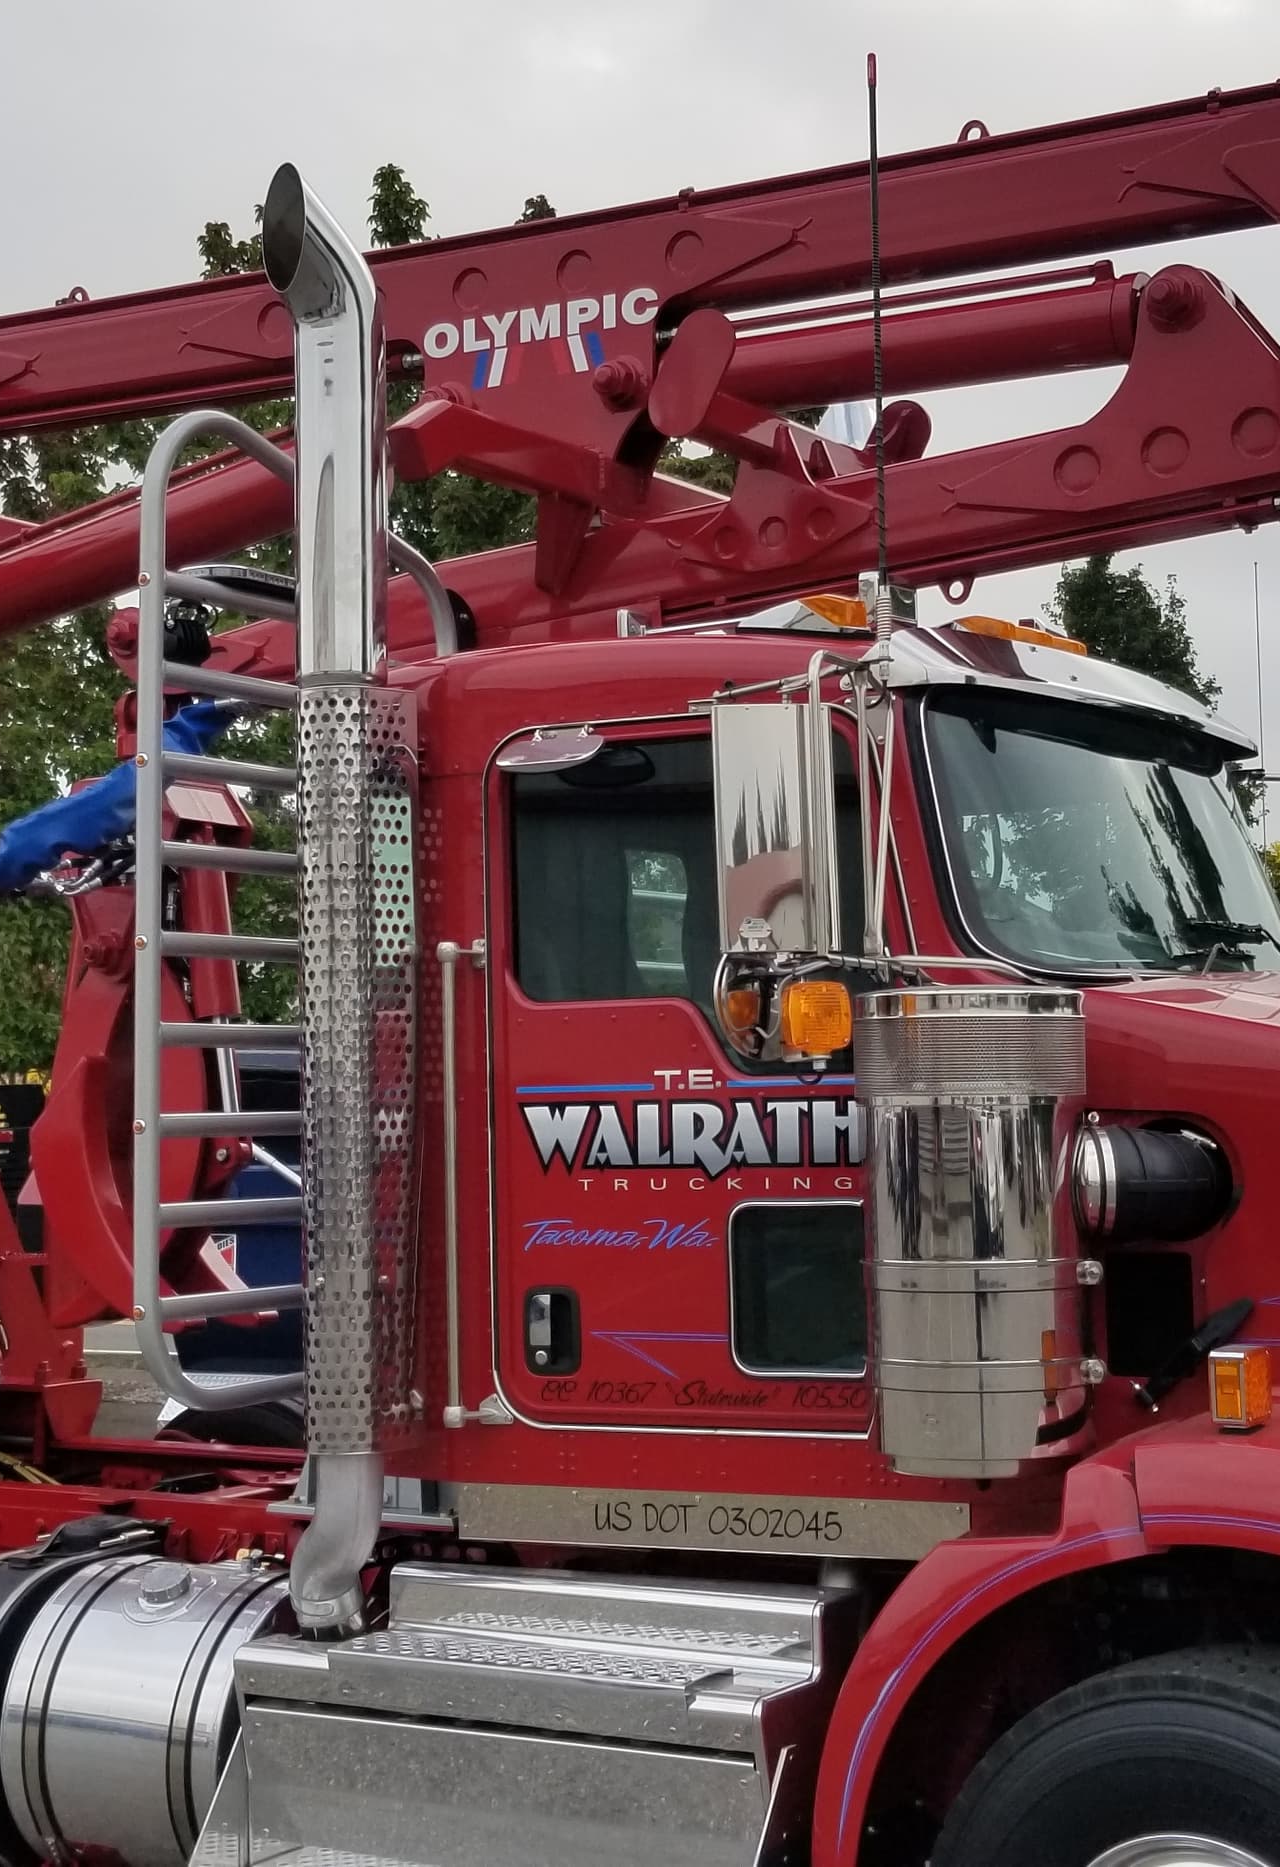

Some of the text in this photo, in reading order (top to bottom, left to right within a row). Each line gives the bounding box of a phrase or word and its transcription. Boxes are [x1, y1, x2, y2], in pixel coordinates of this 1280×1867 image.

[423, 287, 659, 359] OLYMPIC
[653, 1069, 722, 1091] T.E.
[520, 1098, 867, 1181] WALRATH
[577, 1176, 854, 1191] TRUCKING
[522, 1219, 646, 1250] Tacoma,
[594, 1501, 843, 1541] US DOT 0302045
